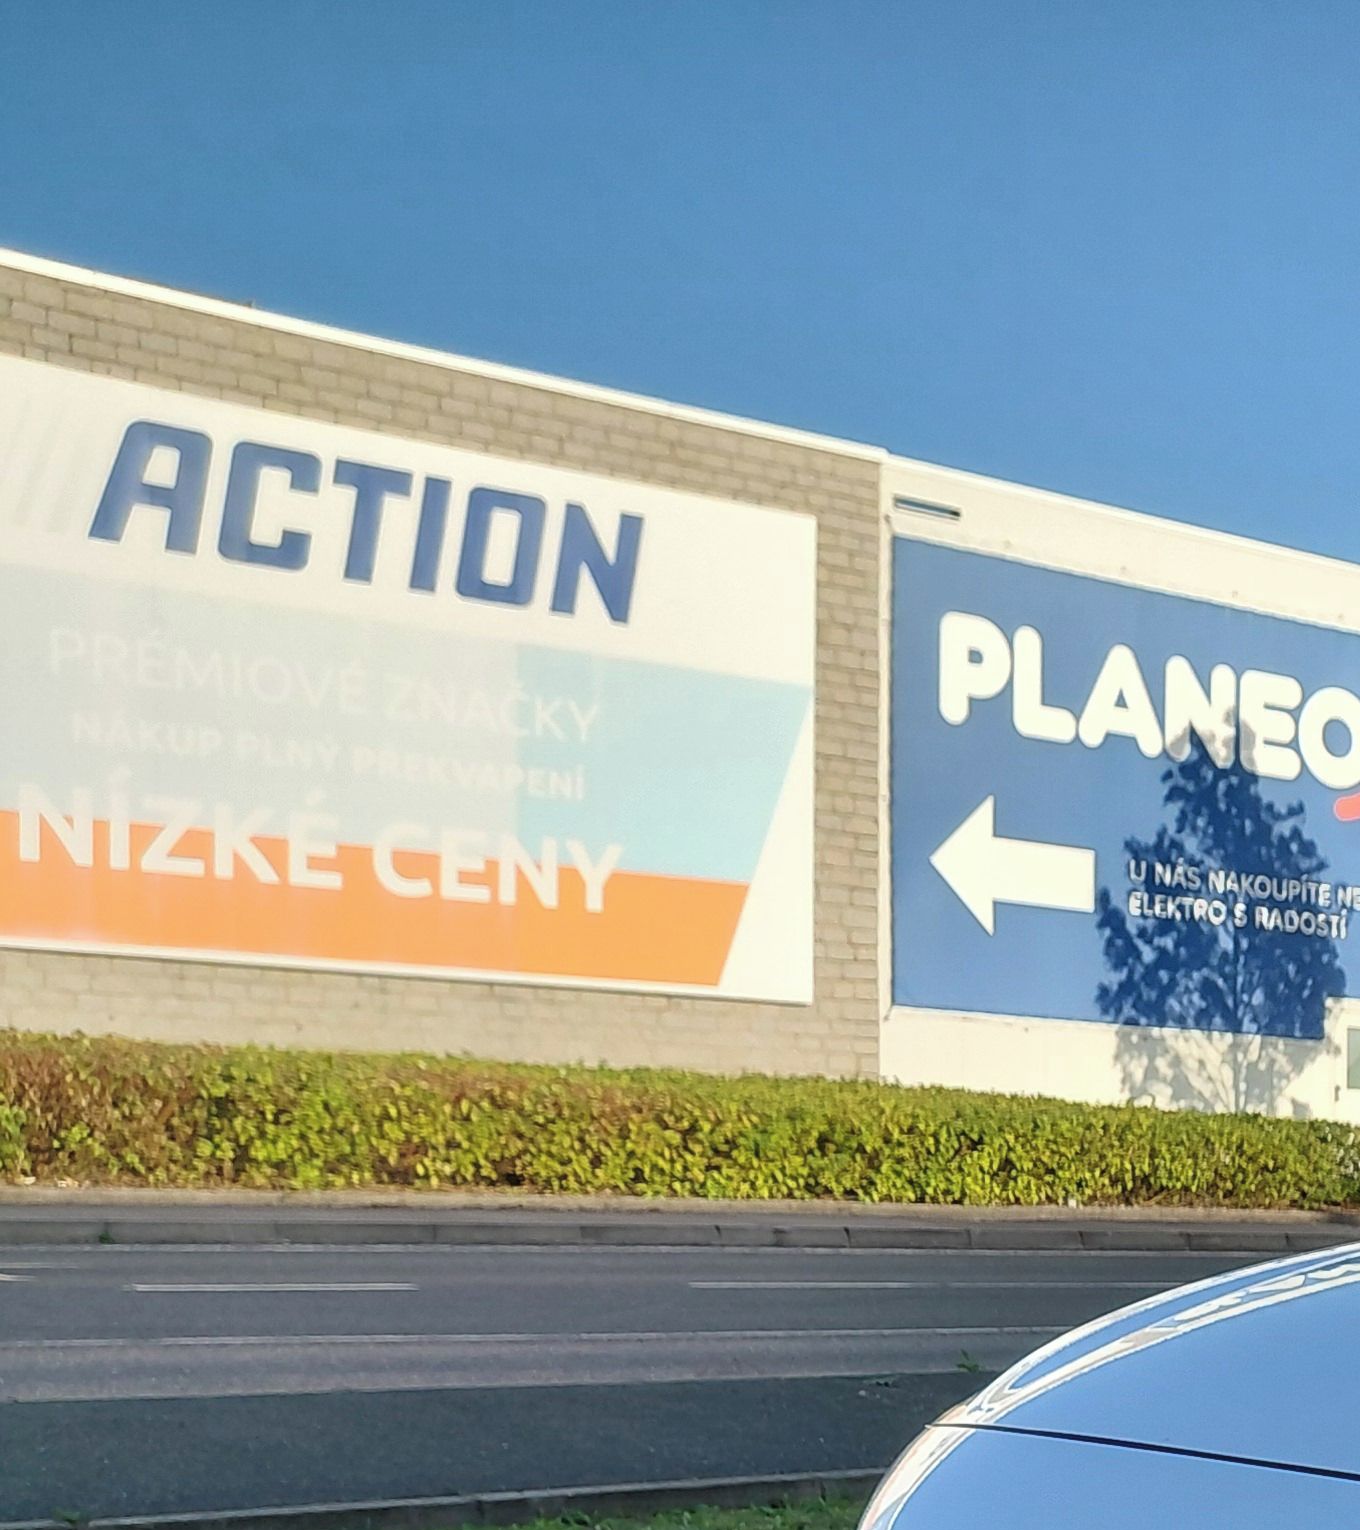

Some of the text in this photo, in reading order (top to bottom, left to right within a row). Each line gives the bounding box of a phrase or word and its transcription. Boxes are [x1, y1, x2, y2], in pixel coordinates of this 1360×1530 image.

[88, 419, 645, 625] ACTION
[383, 673, 600, 743] ZNAČKY
[18, 765, 624, 914] NÍZKÉ CENY
[1128, 891, 1348, 940] ELEKTRO S RADOSTÍ
[1129, 859, 1147, 884] U
[1154, 856, 1201, 890] NÁS
[1208, 868, 1331, 908] NAKOUPÍTE
